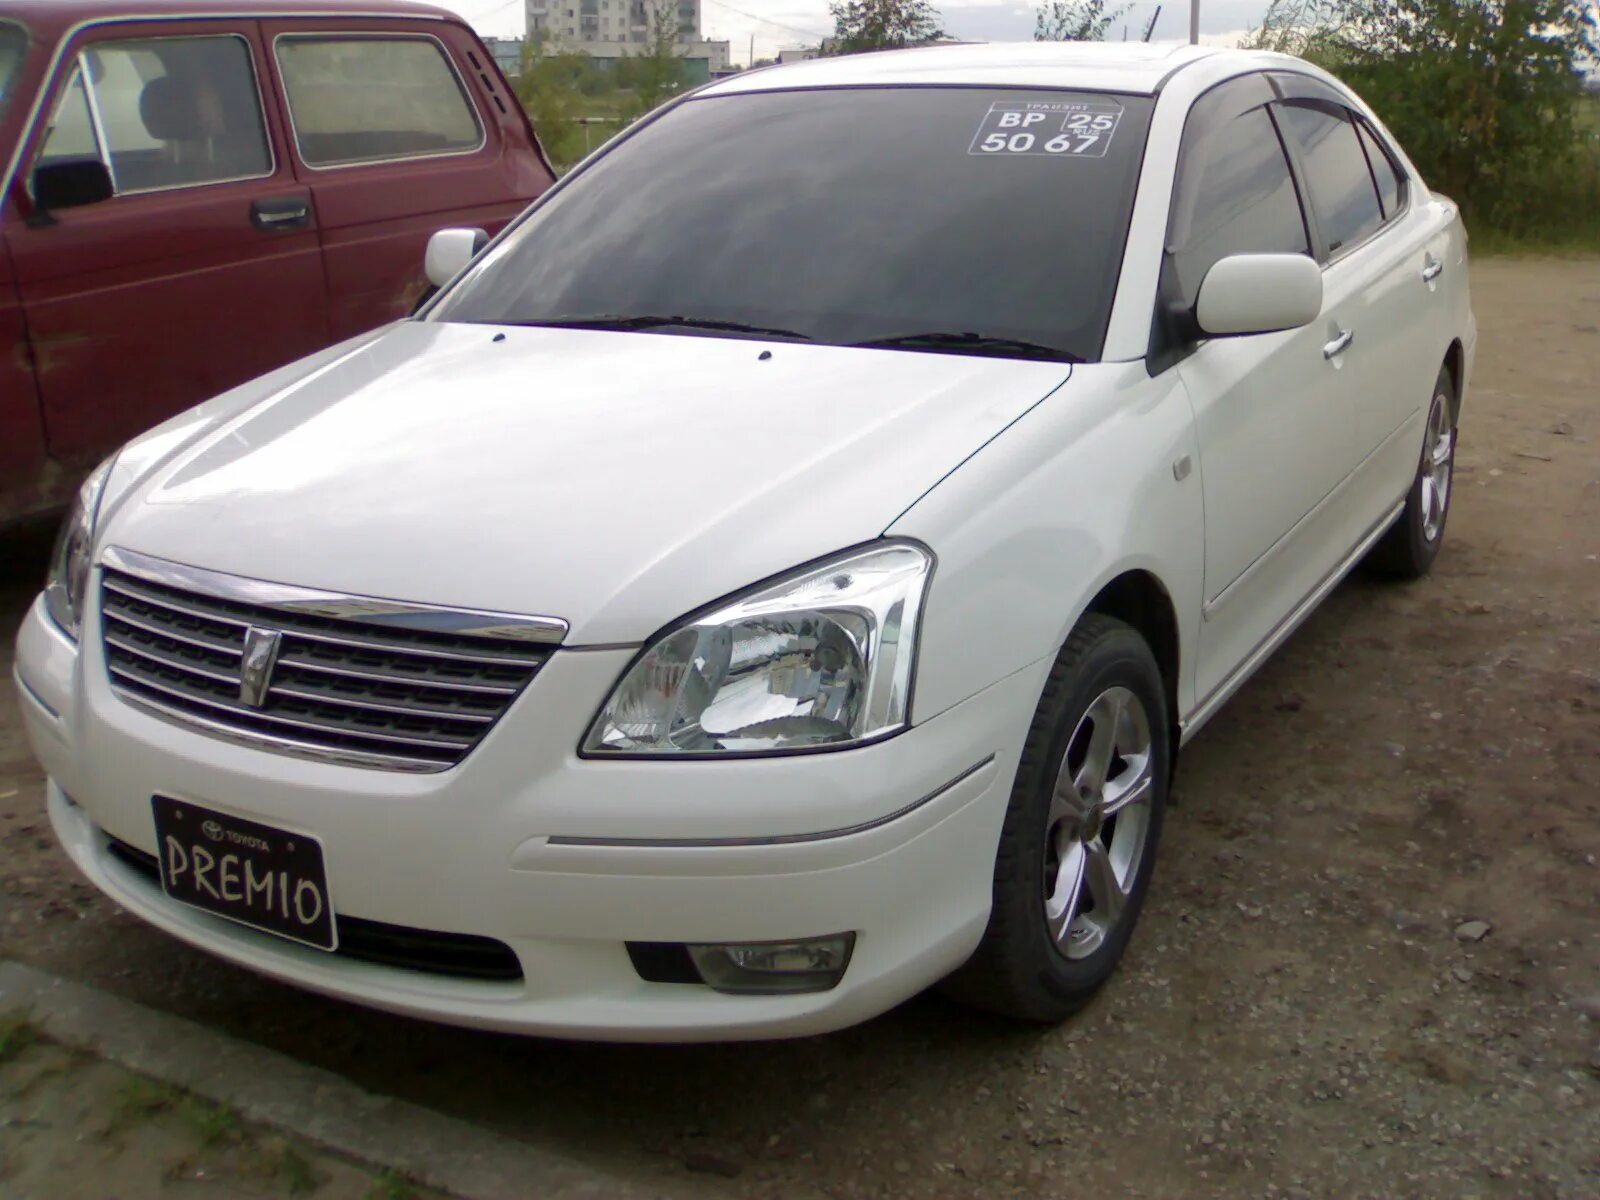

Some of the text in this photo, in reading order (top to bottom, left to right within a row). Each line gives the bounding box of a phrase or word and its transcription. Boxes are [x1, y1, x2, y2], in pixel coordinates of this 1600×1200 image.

[1067, 114, 1113, 130] 25
[980, 133, 1099, 154] 50 67
[225, 829, 270, 851] TOYOTA
[166, 834, 322, 925] PREMIO
